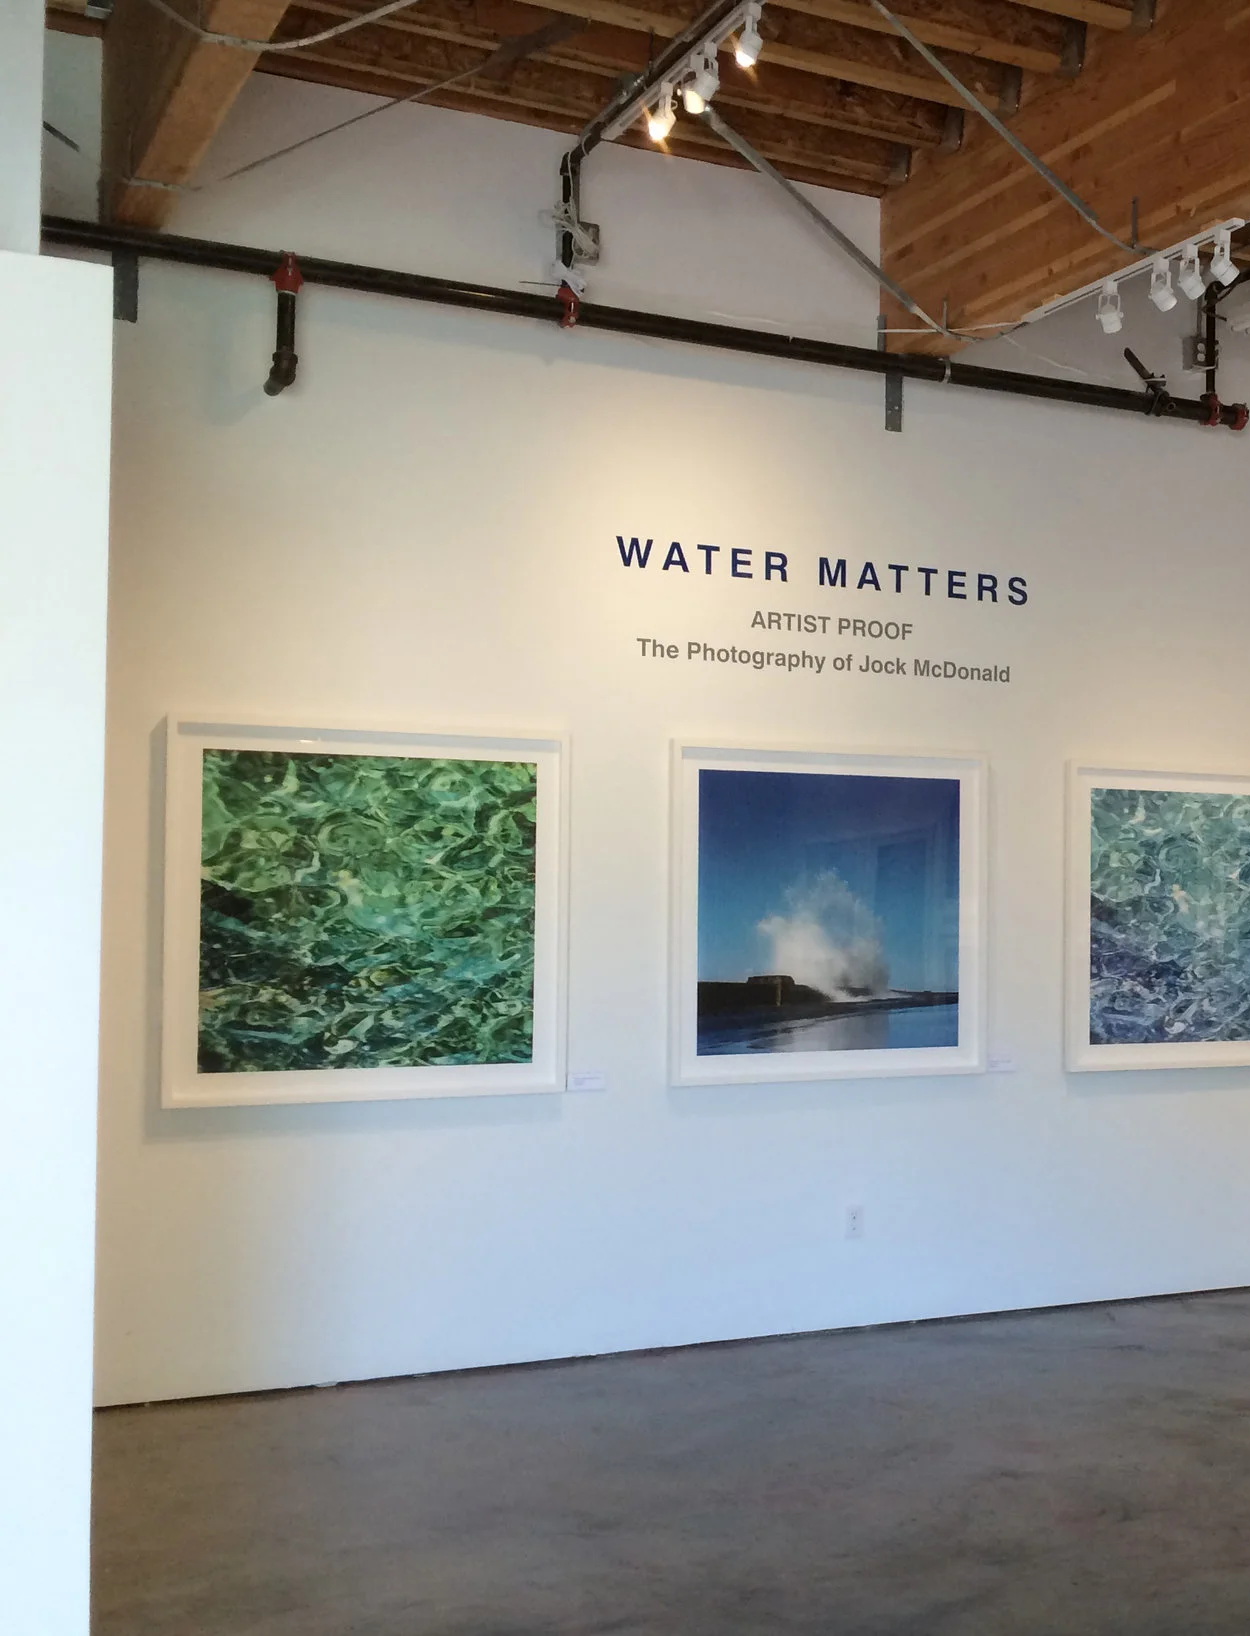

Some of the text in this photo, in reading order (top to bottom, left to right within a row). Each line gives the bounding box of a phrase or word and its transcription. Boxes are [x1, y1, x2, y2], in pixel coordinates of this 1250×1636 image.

[616, 535, 1029, 606] WATER MATTERS
[751, 610, 913, 641] ARTIST PROOF
[636, 637, 1010, 683] The Photography of Jock McDonald
